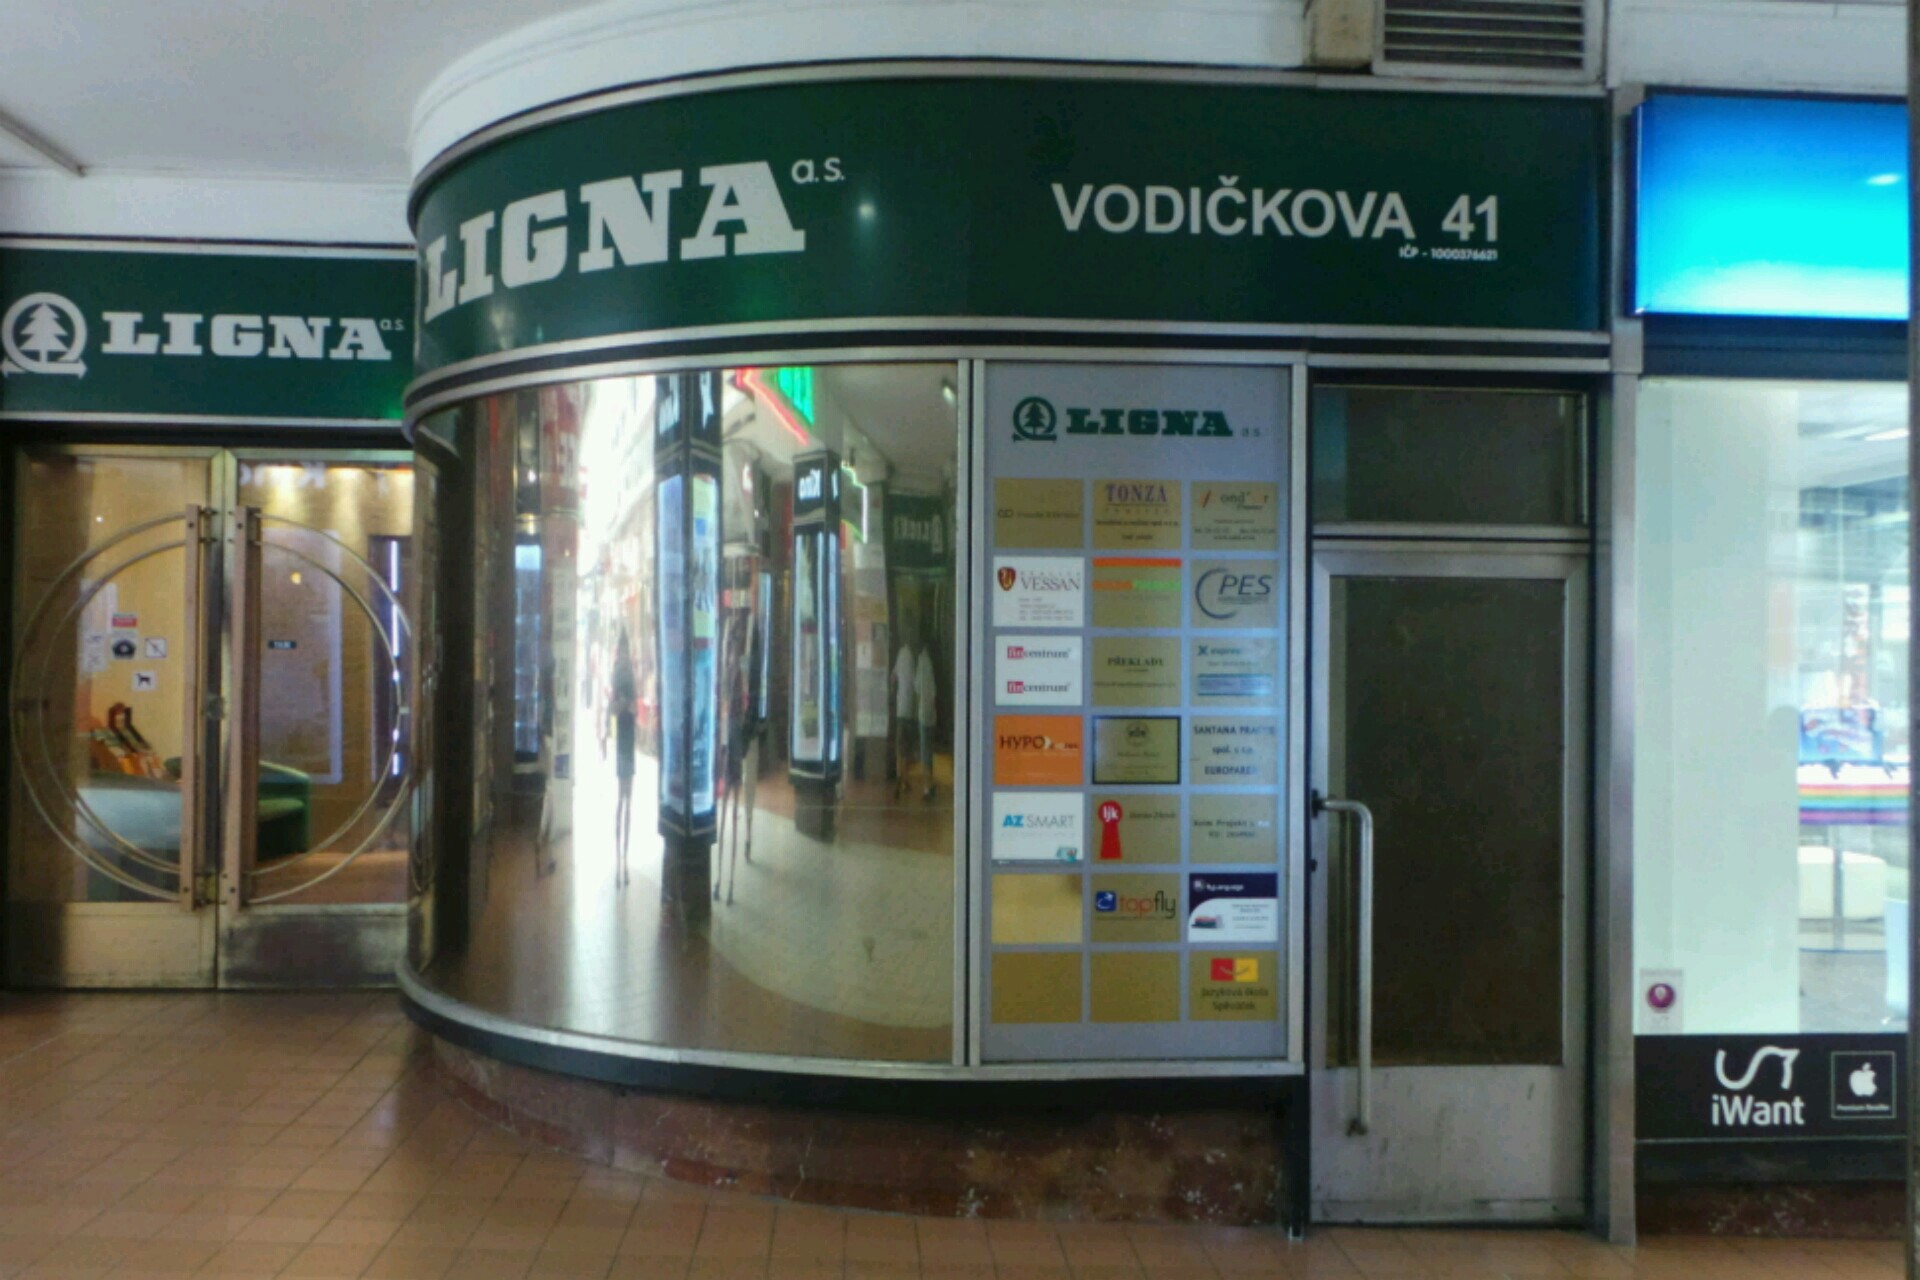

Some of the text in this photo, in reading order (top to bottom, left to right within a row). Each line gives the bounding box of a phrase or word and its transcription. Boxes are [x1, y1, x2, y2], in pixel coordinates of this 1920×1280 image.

[1052, 174, 1499, 243] VODIČKOVA 41
[423, 156, 846, 324] LIGNA a.s.
[101, 311, 393, 361] LIGNA
[1065, 407, 1235, 437] LIGNA
[1105, 483, 1168, 502] TONZA
[1020, 577, 1081, 592] VESSAN
[1002, 814, 1077, 829] AZ SMART
[1118, 890, 1177, 920] topfly
[1711, 1093, 1805, 1126] iWant
